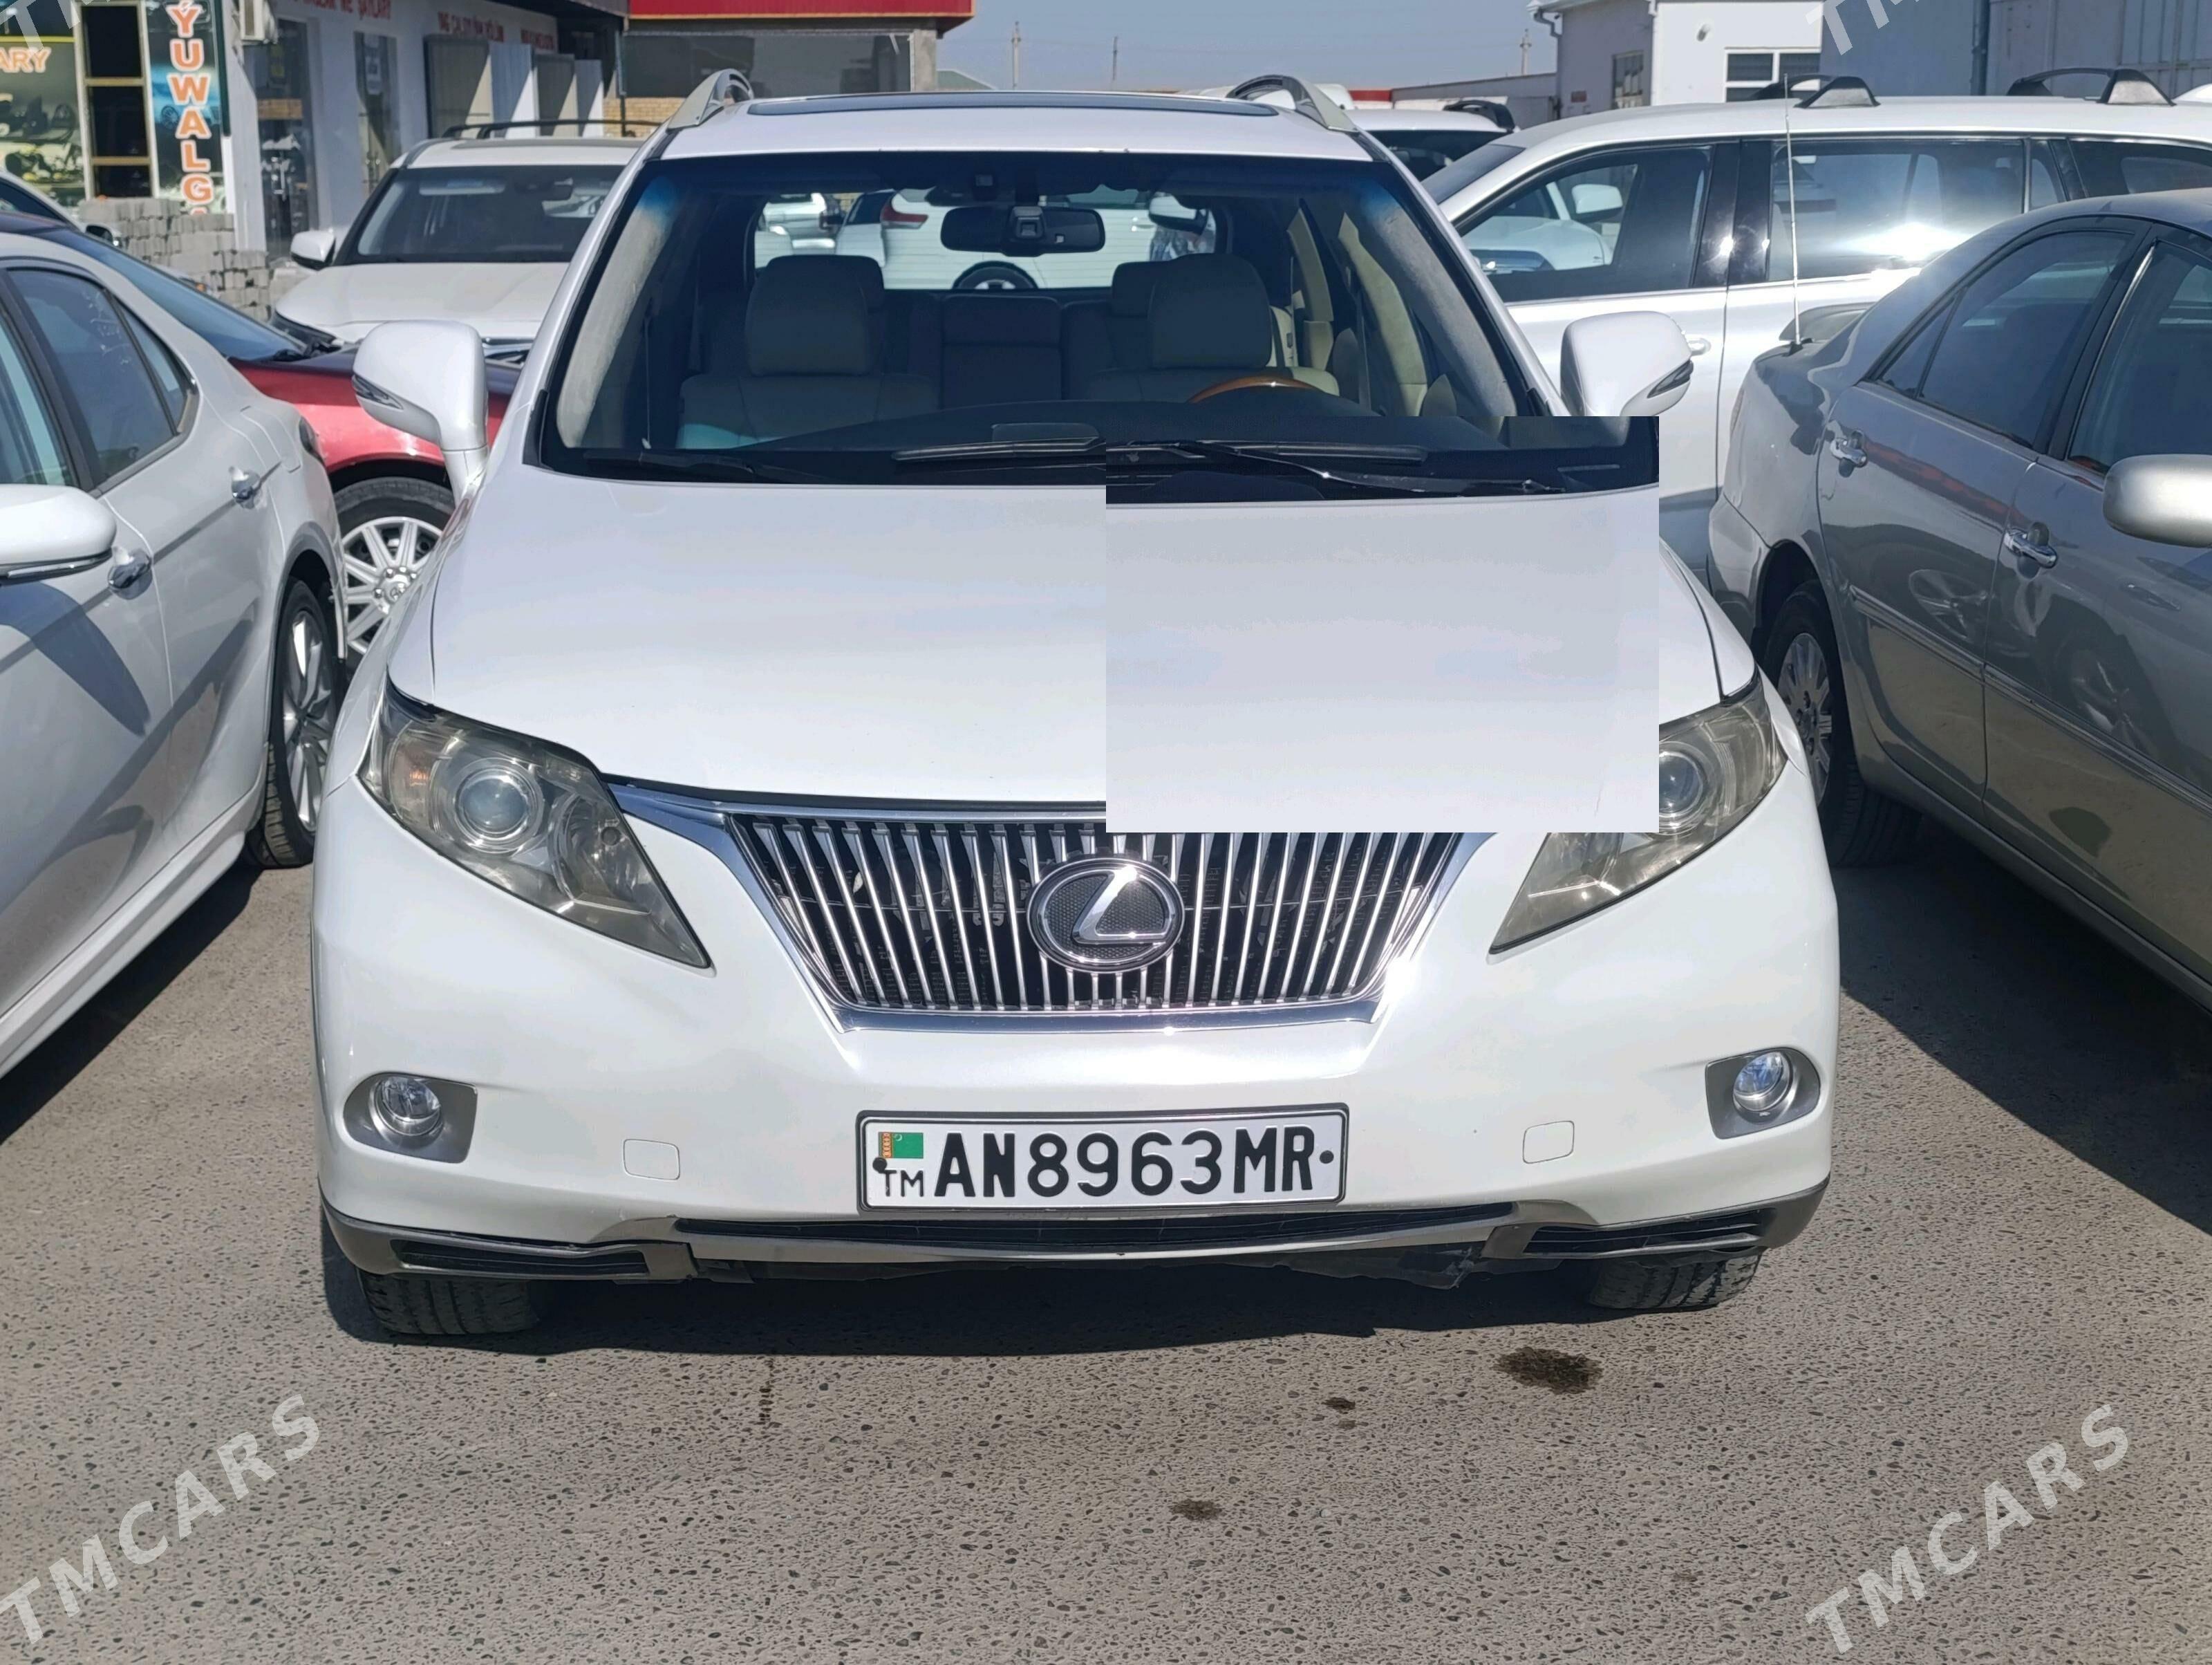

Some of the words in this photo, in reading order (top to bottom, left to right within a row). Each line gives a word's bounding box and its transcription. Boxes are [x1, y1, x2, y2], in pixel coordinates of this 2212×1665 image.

[166, 0, 214, 216] ÝUWALG
[878, 1169, 924, 1198] TM
[934, 1124, 1315, 1198] AN8963MR
